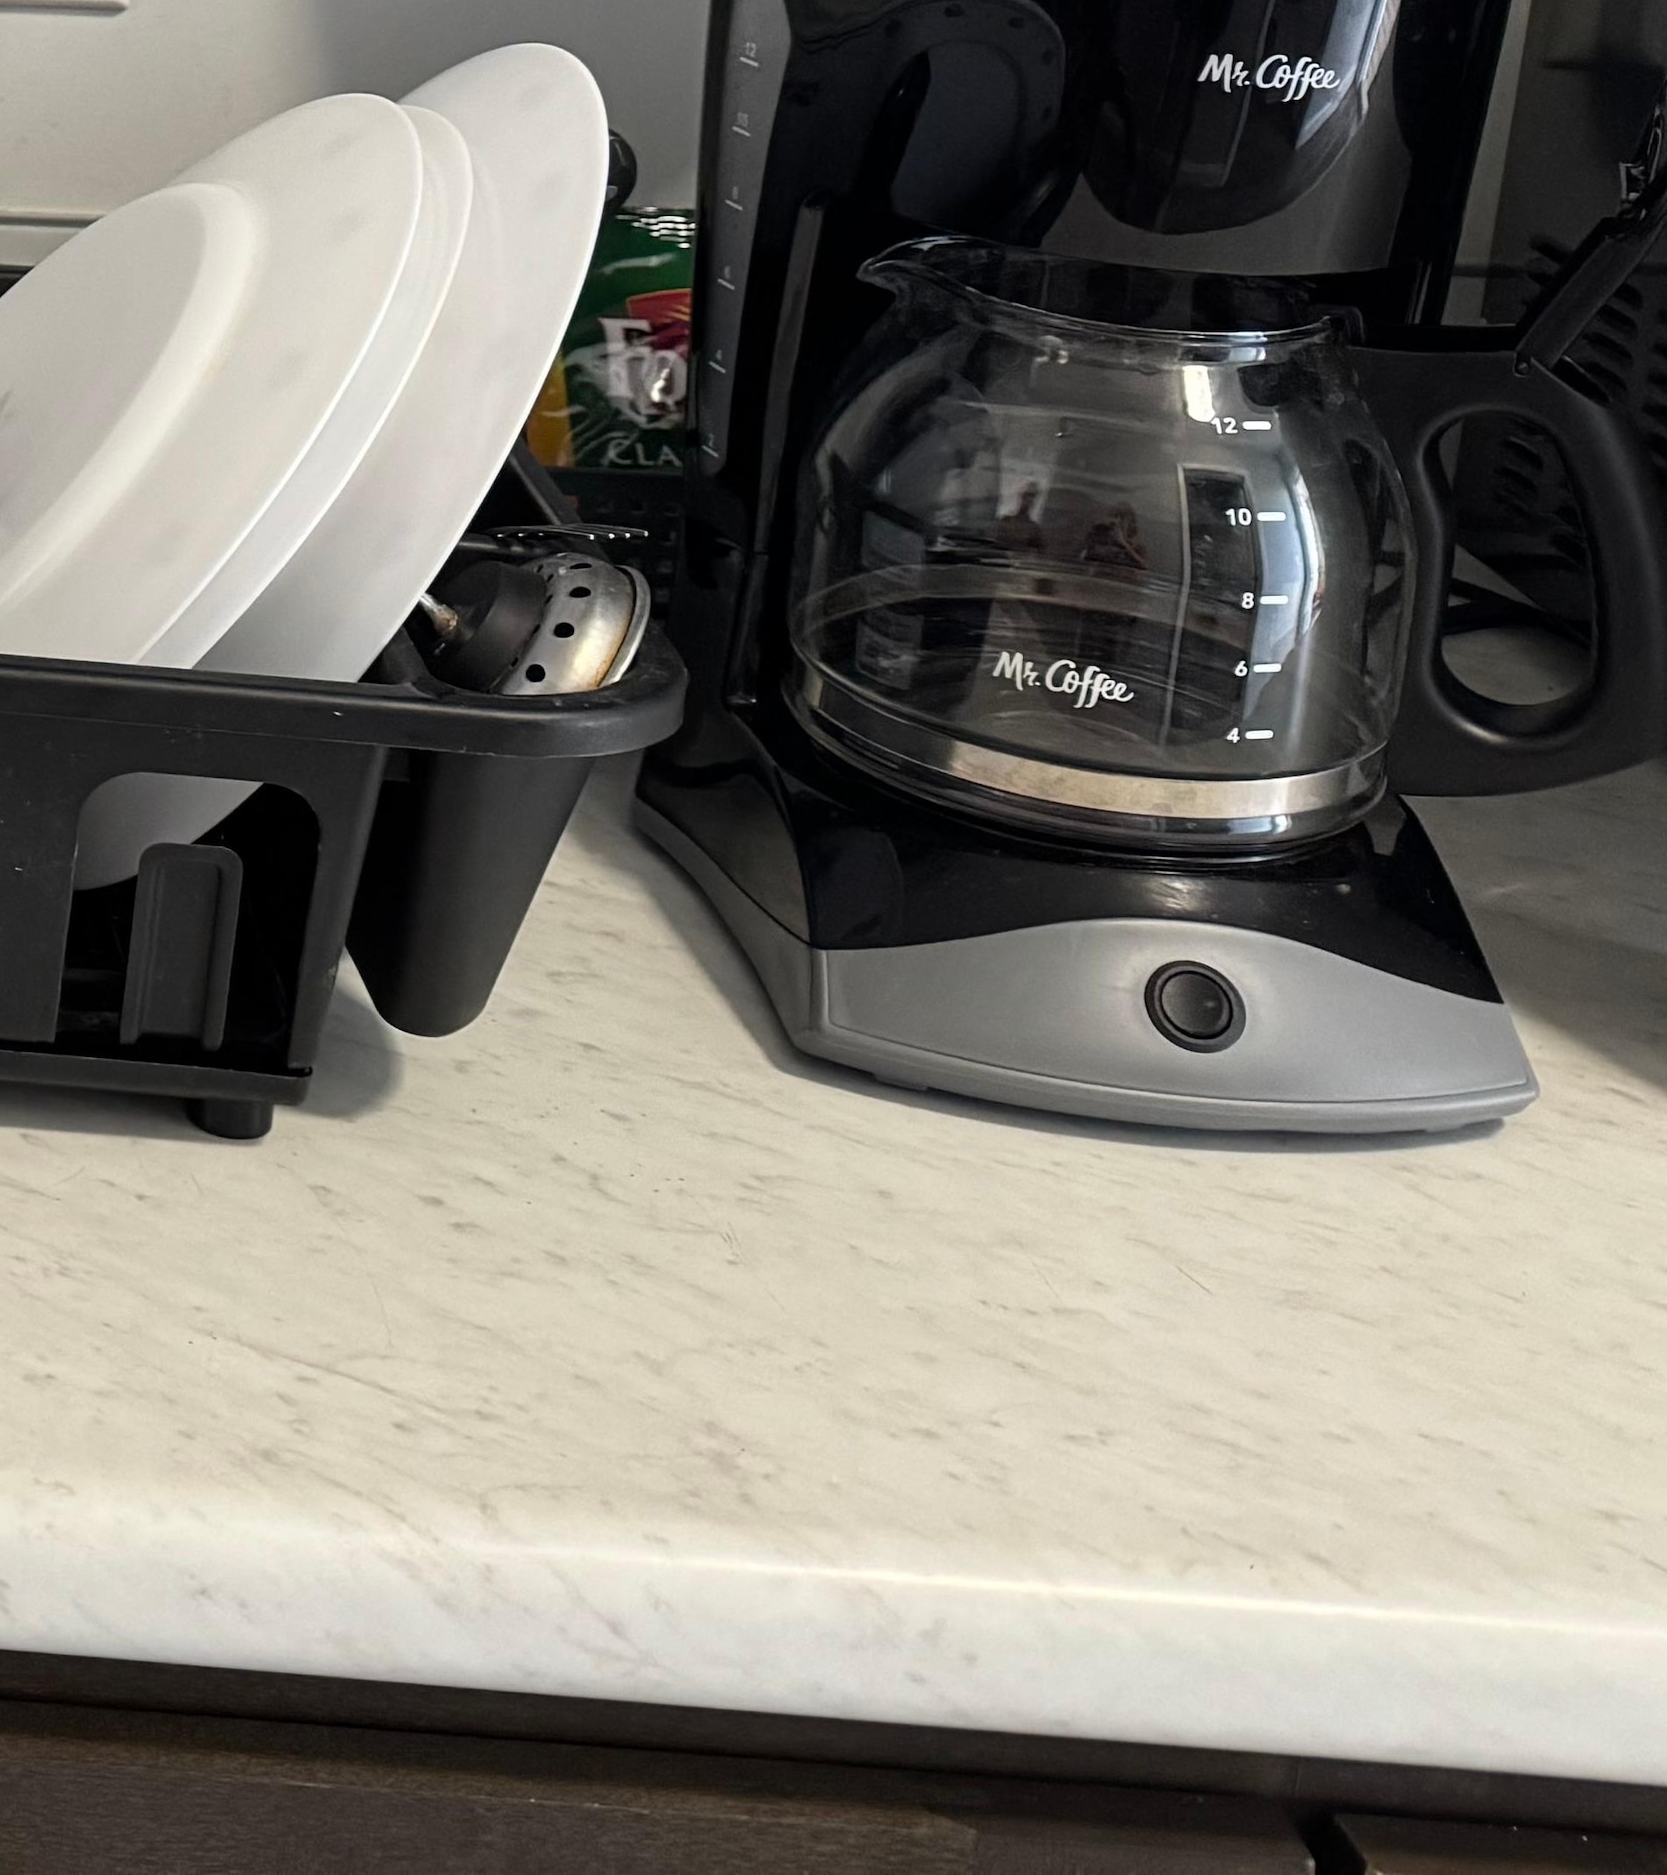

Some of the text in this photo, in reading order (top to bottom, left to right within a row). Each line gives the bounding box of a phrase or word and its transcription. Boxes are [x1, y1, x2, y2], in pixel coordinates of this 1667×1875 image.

[1197, 53, 1341, 103] Mr. Coffee
[1211, 417, 1238, 435] 12
[1224, 508, 1252, 527] 10
[1241, 592, 1255, 610] 8
[1234, 660, 1248, 677] 6
[992, 649, 1135, 709] Mr. Coffee
[1226, 727, 1240, 744] 4
